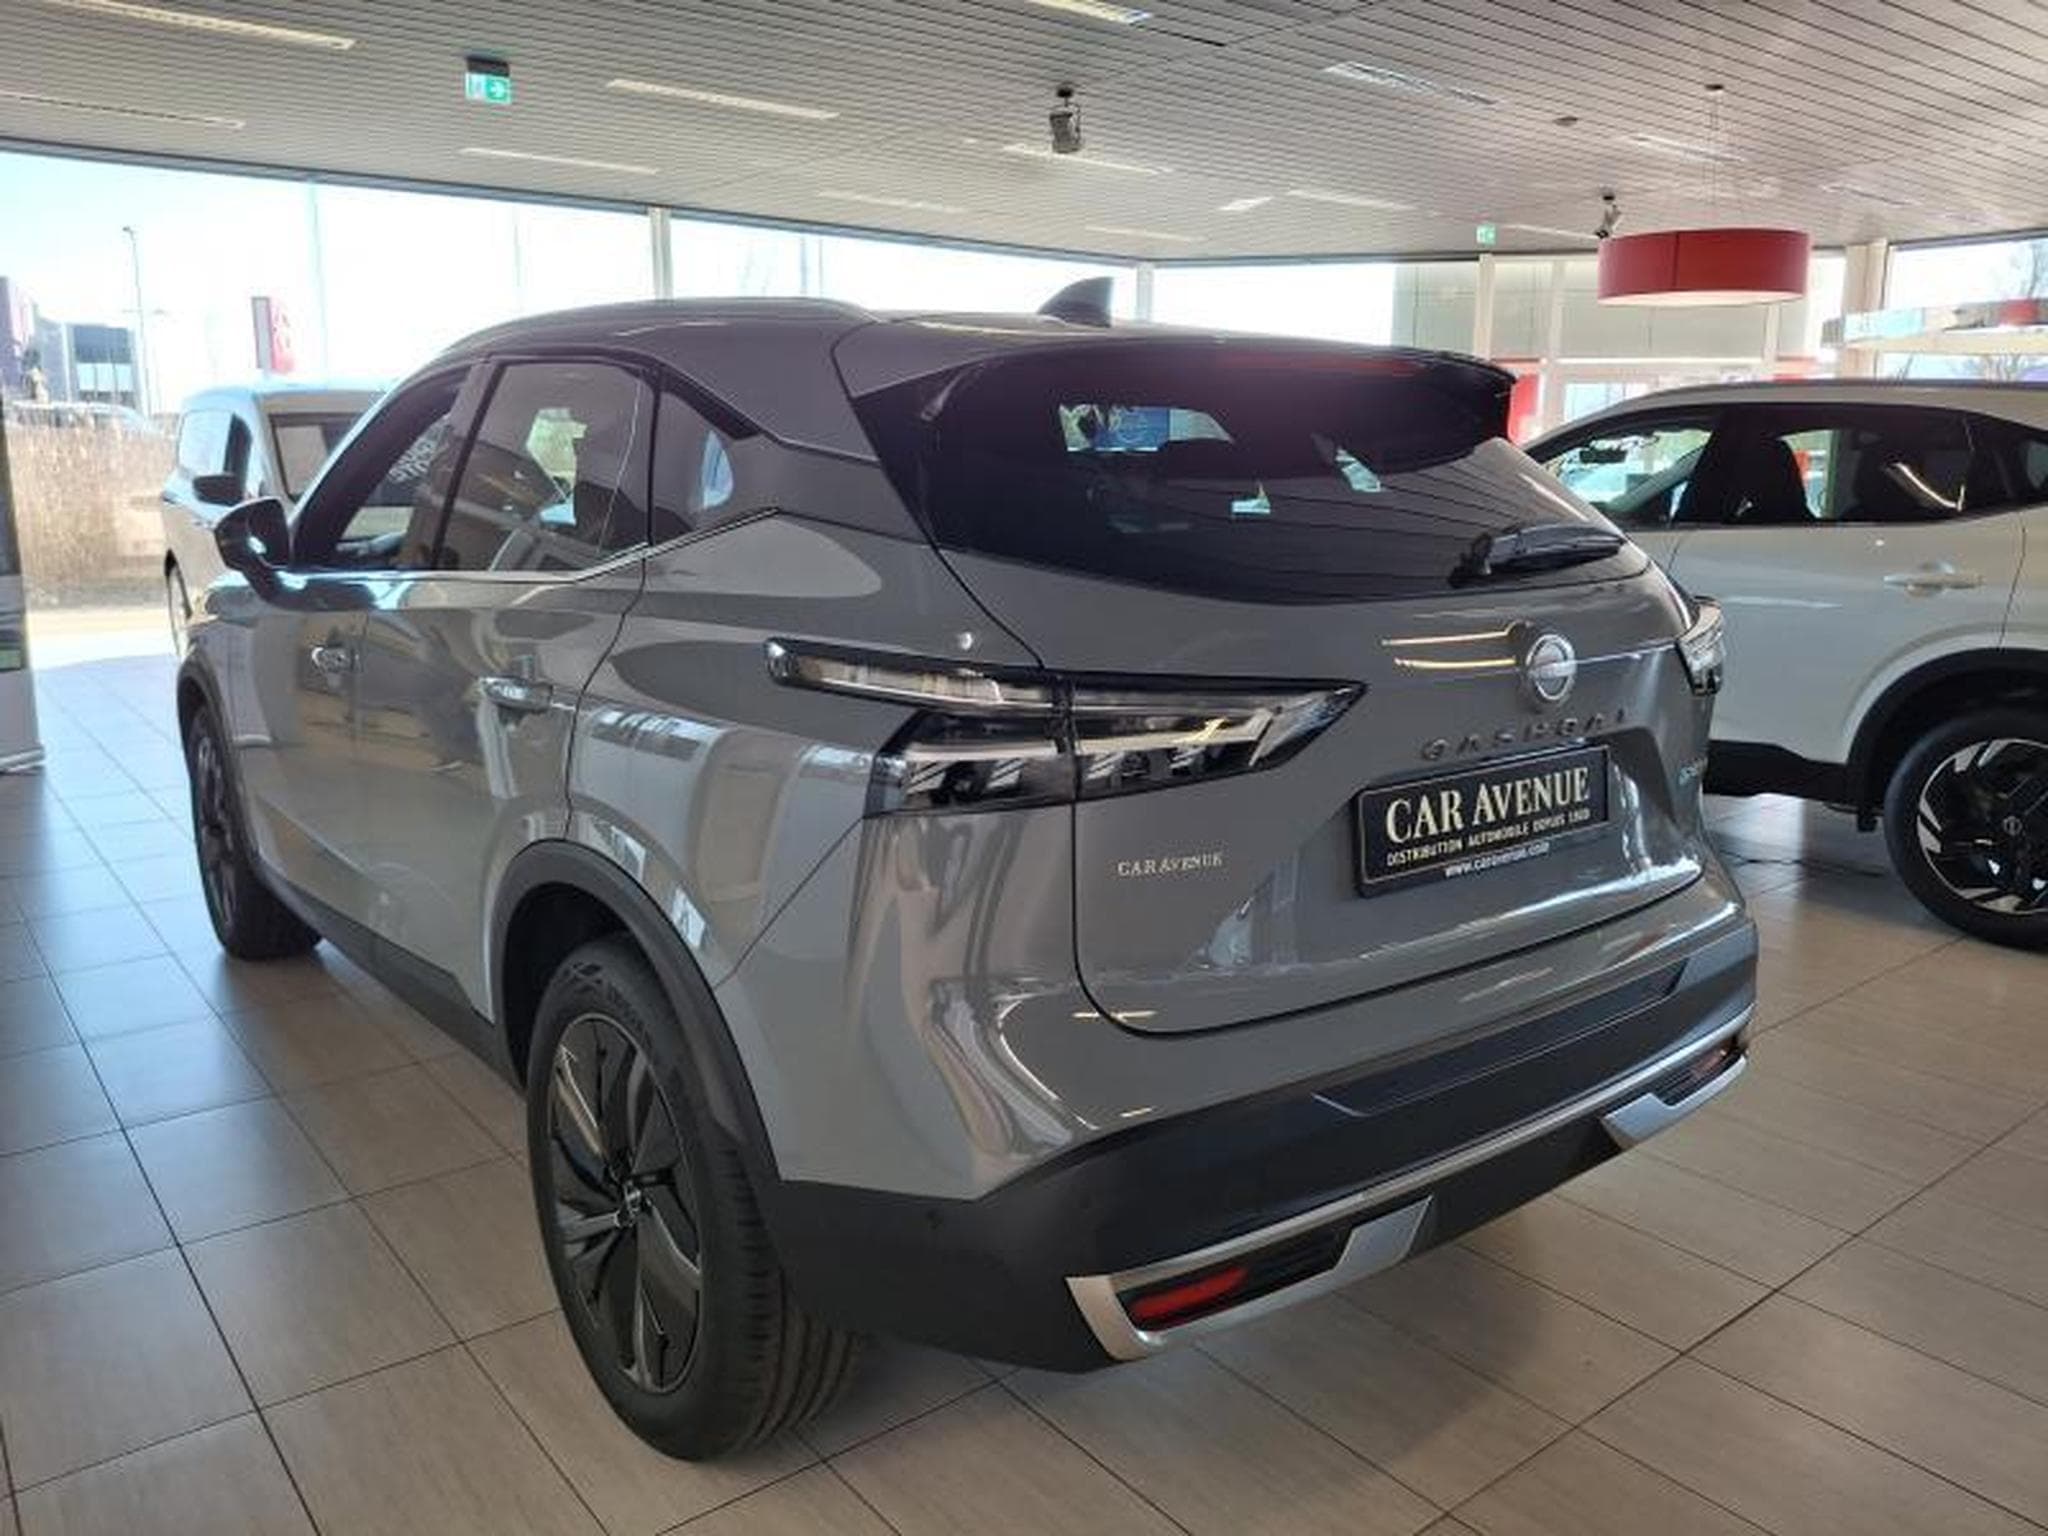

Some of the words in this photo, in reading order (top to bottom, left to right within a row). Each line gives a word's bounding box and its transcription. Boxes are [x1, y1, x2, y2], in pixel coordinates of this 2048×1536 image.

[1386, 789, 1464, 843] CAR
[1473, 767, 1590, 826] AVENUE
[1387, 839, 1463, 867] DISTRIBUTION
[1468, 821, 1529, 847] AUTOMOBILE
